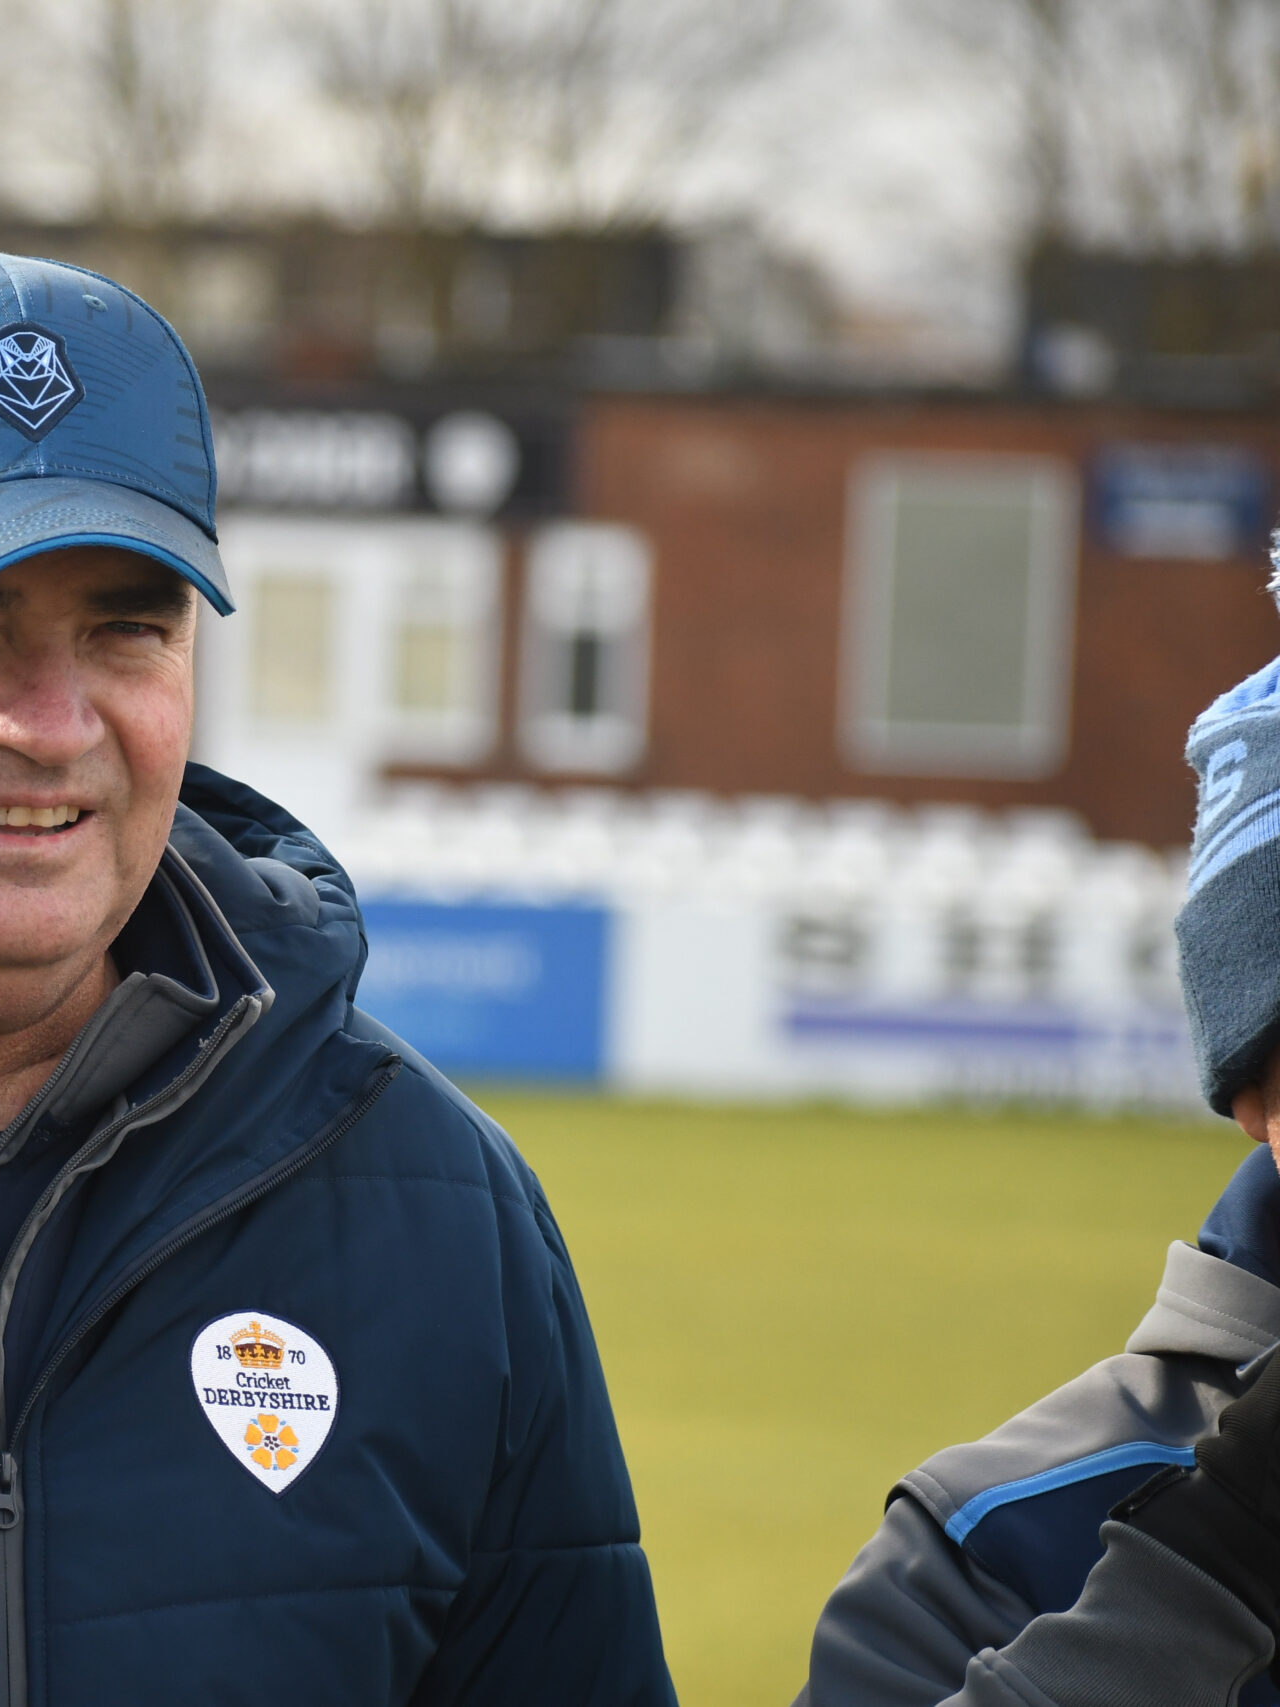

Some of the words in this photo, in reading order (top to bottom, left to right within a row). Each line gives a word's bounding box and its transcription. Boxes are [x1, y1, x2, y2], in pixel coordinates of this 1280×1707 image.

[215, 1344, 232, 1360] 18
[288, 1349, 306, 1365] 70
[235, 1371, 292, 1391] Cricket
[202, 1387, 331, 1411] DERBYSHIRE
